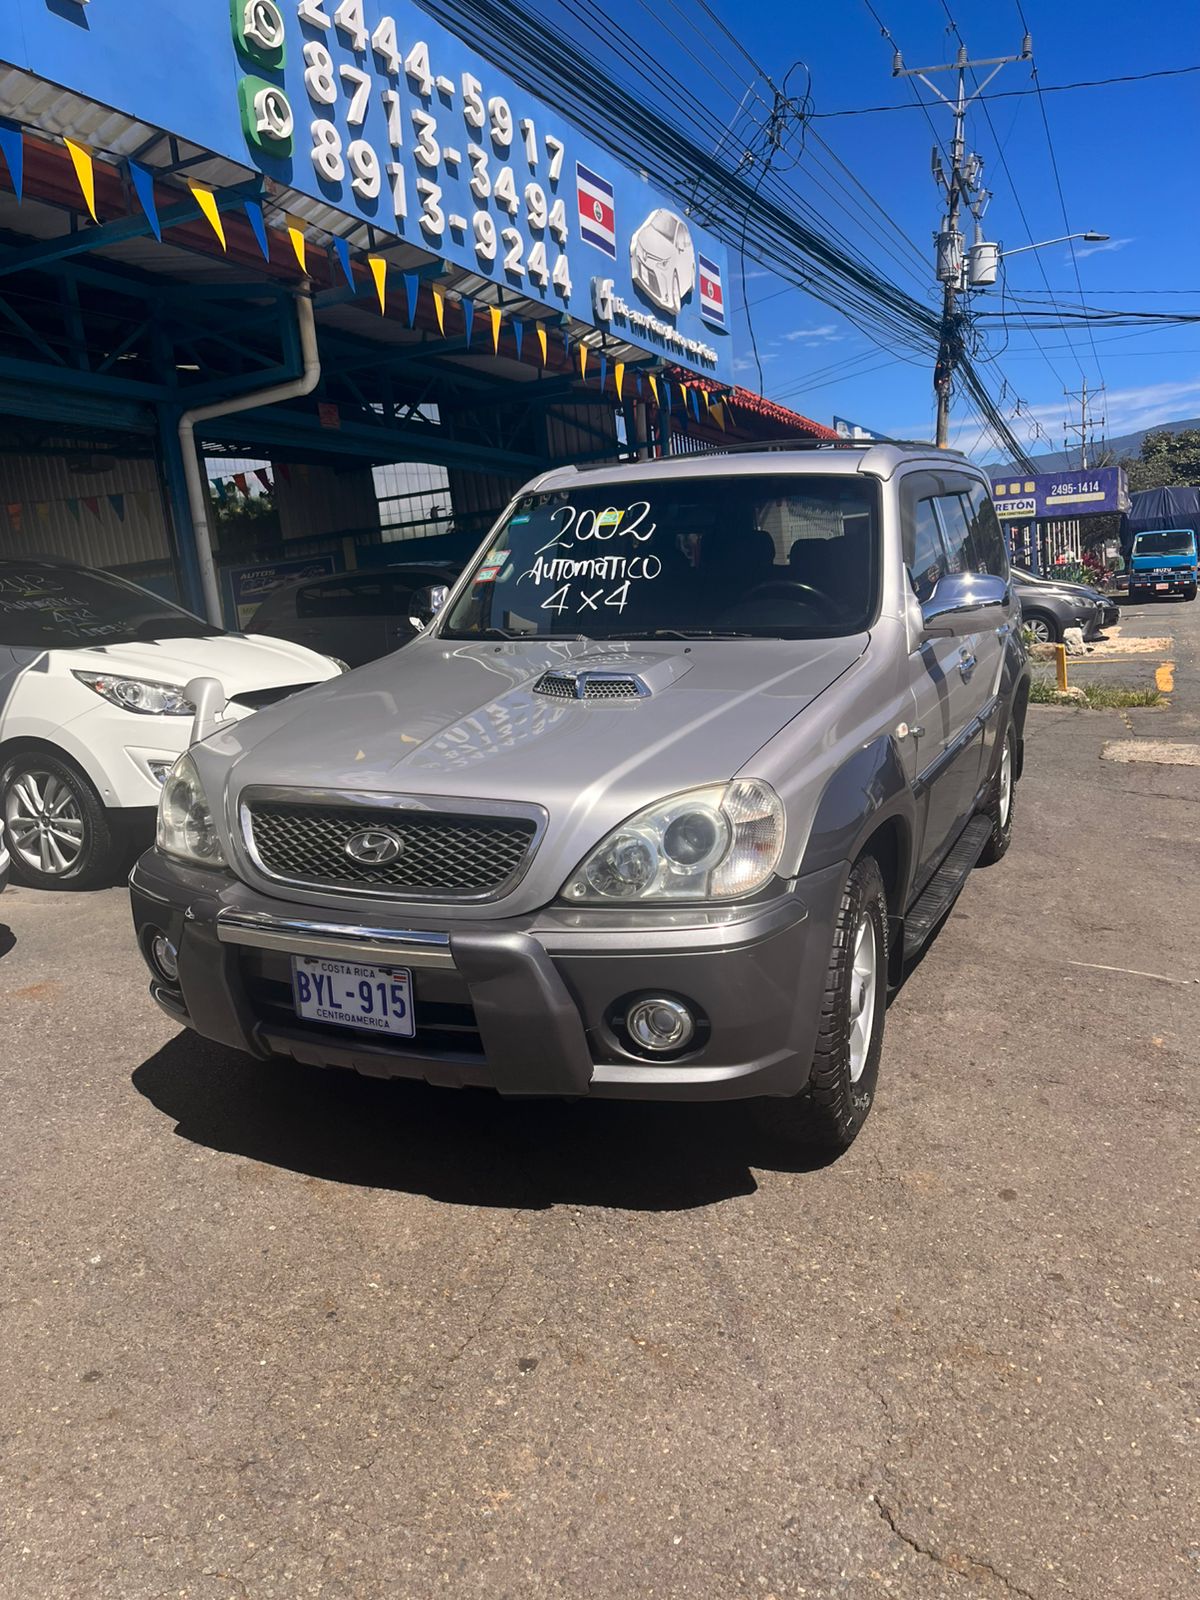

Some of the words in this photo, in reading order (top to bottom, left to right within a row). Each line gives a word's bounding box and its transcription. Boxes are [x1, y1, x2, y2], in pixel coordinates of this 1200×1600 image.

[303, 40, 567, 244] 8713-3494
[310, 118, 572, 298] 8913-9244
[1051, 481, 1099, 496] 2495-1414
[534, 501, 656, 555] 2002
[296, 970, 406, 1019] BYL-915
[321, 962, 352, 976] COSTA
[354, 967, 376, 979] RICA
[316, 1008, 391, 1029] CENTROAMERICA
